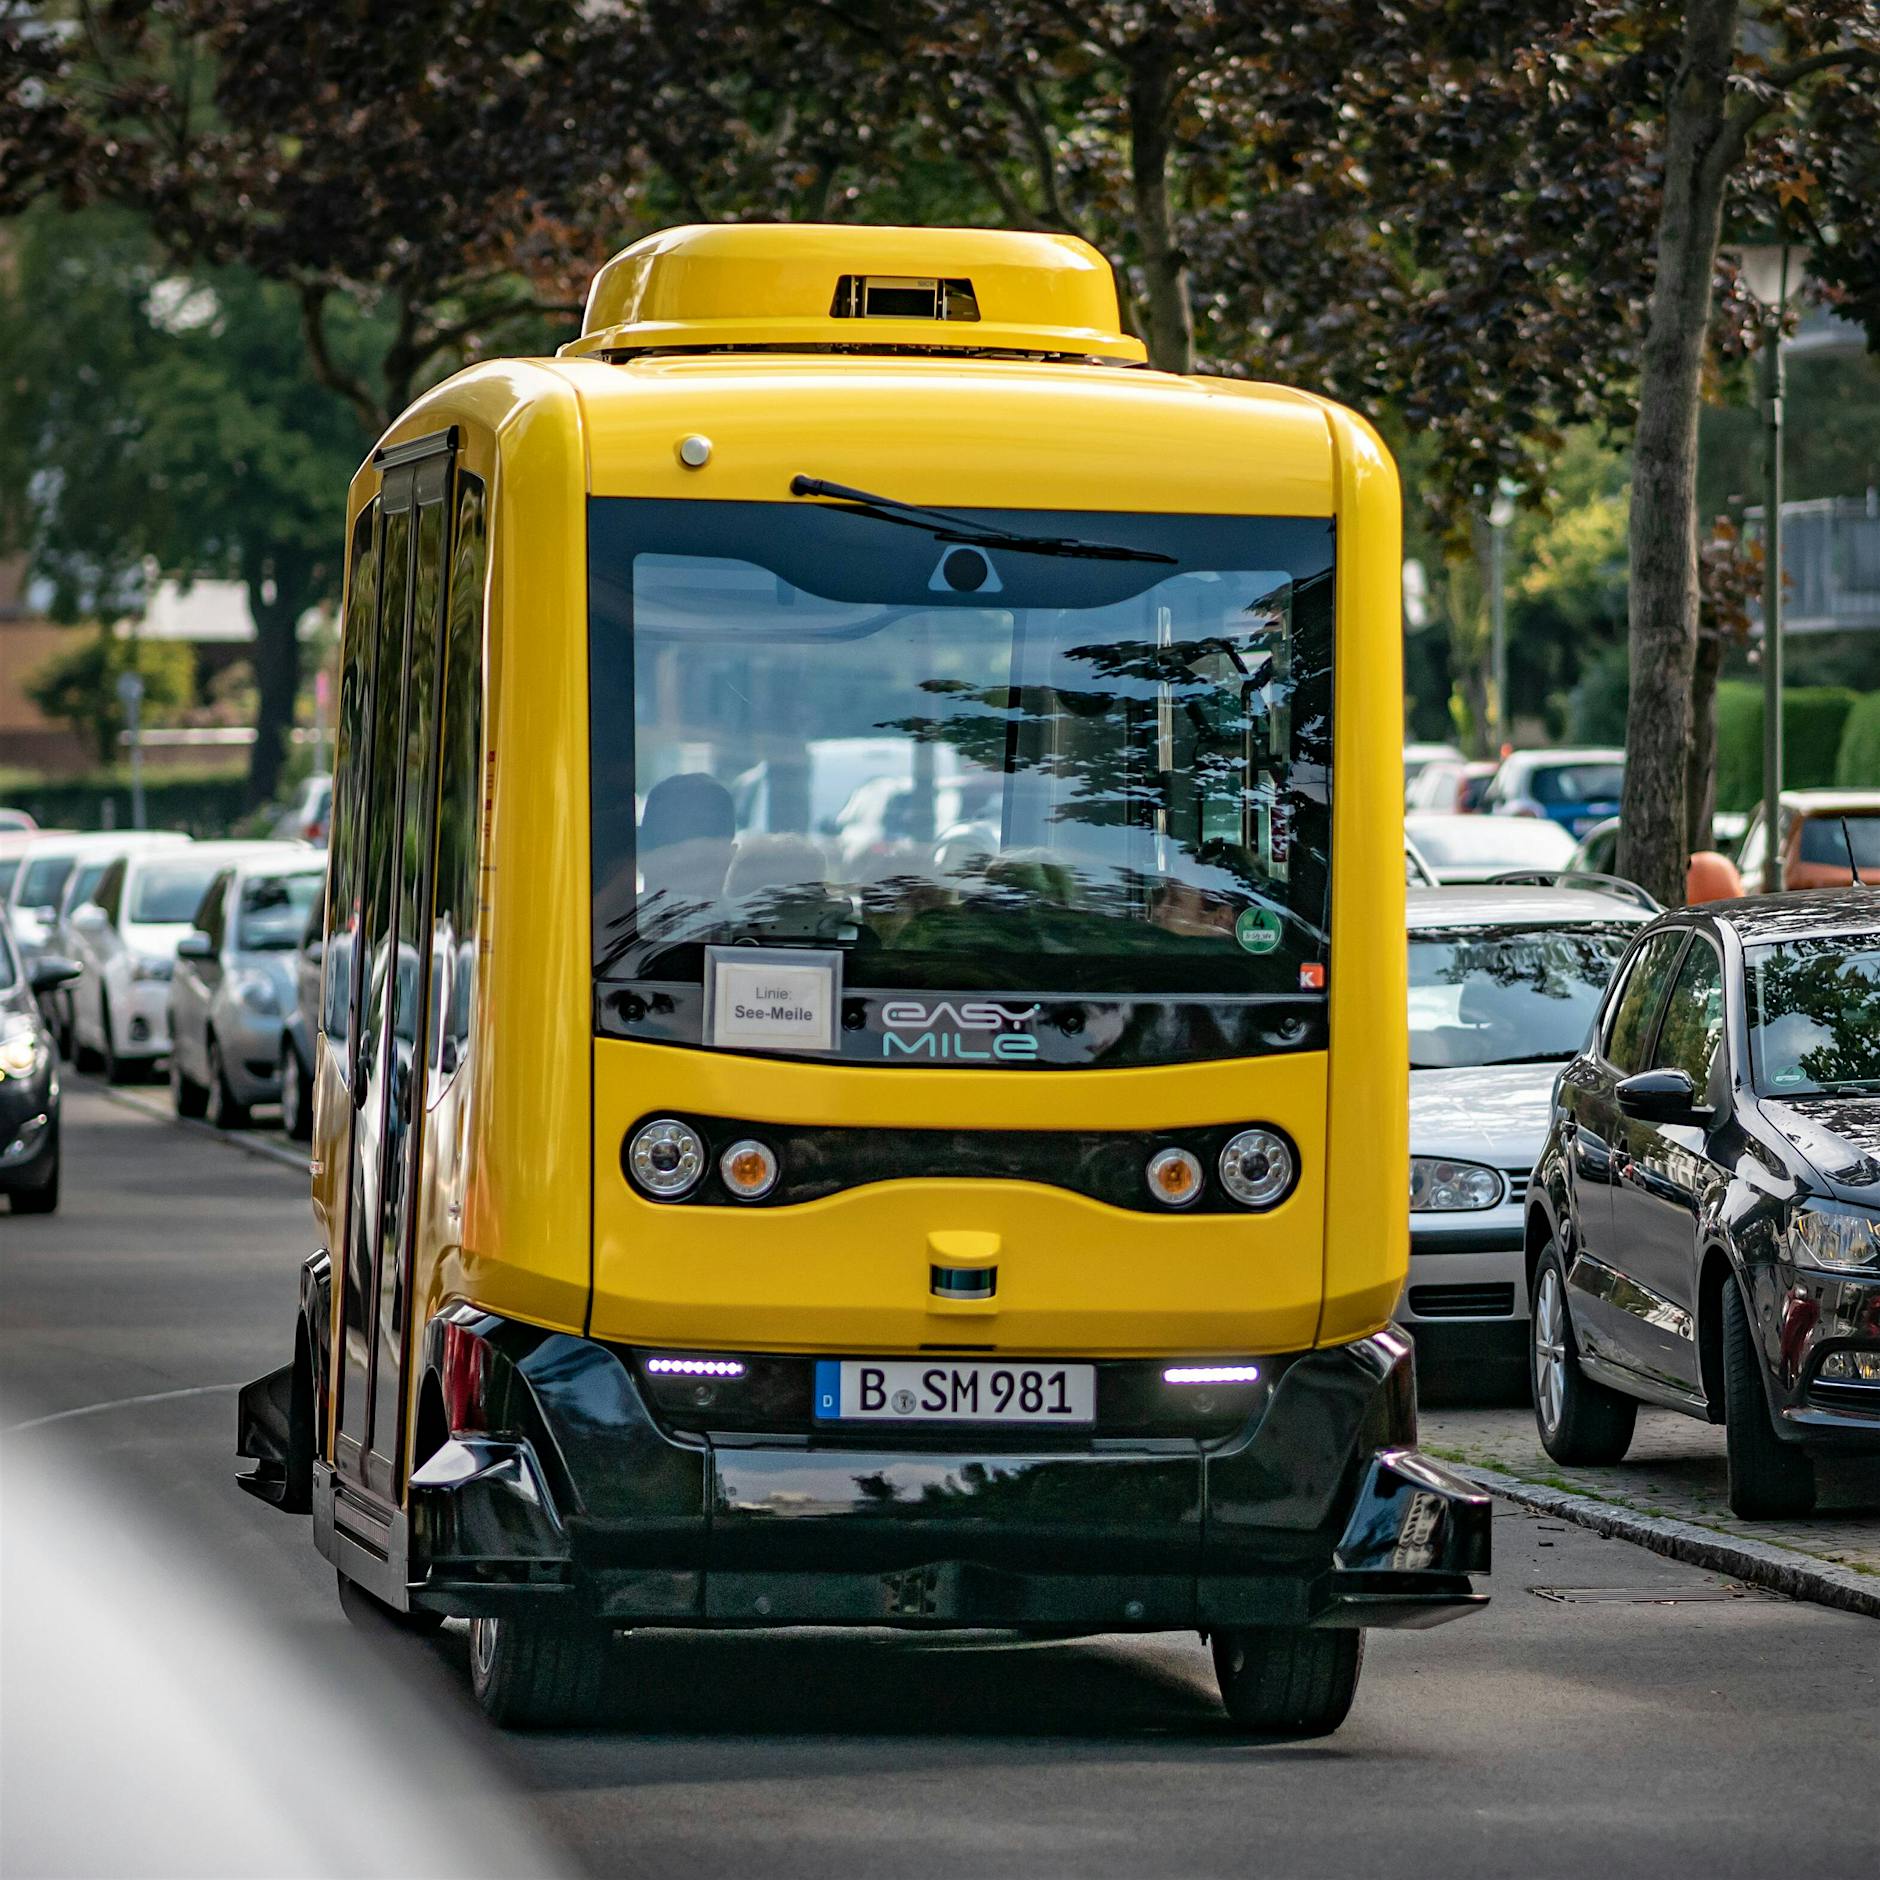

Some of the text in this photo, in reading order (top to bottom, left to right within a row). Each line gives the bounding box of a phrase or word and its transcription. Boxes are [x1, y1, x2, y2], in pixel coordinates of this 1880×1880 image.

[1253, 910, 1265, 929] 4
[1300, 971, 1315, 988] K
[755, 986, 792, 1000] Linie:
[735, 1005, 813, 1021] See-Meile
[860, 1368, 1072, 1413] B SM 981
[822, 1395, 832, 1407] D
